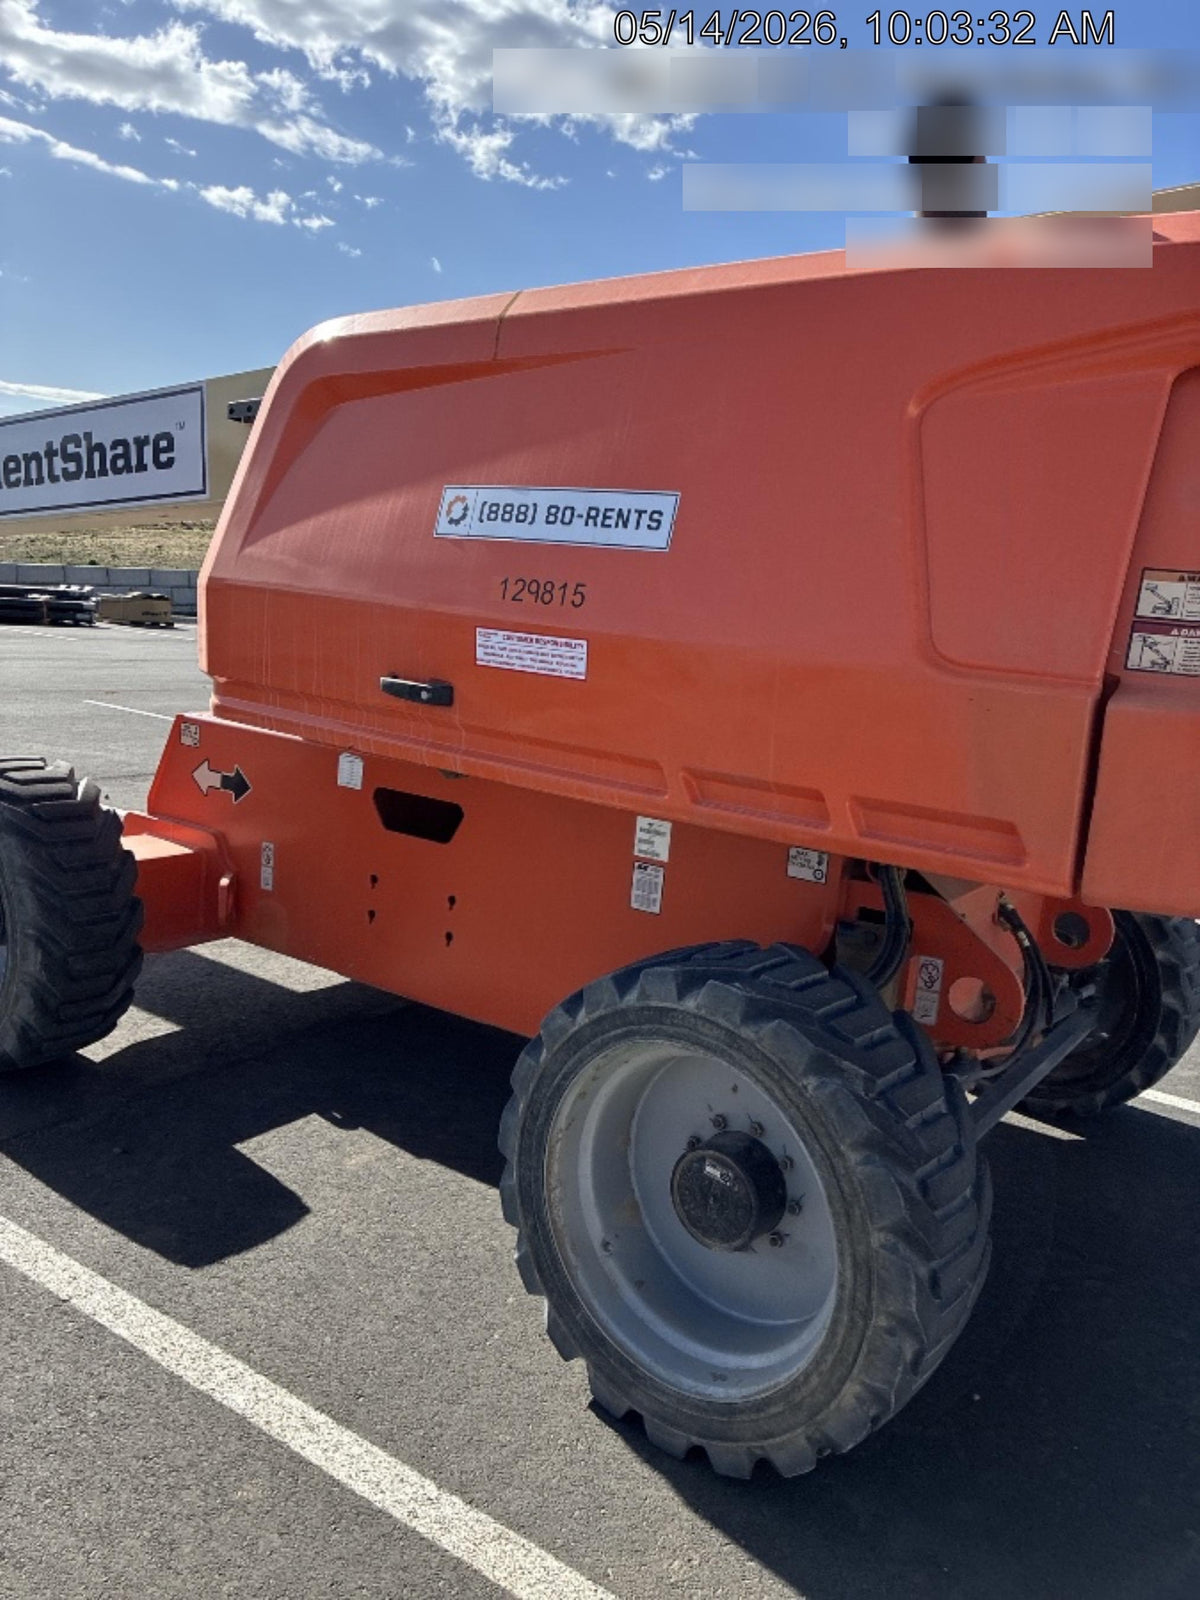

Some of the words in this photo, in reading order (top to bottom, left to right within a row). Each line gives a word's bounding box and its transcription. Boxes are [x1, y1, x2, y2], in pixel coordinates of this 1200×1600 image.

[0, 431, 175, 489] entShare
[478, 501, 538, 526] (888)
[545, 504, 664, 531] 80-RENTS
[500, 577, 587, 608] 129815
